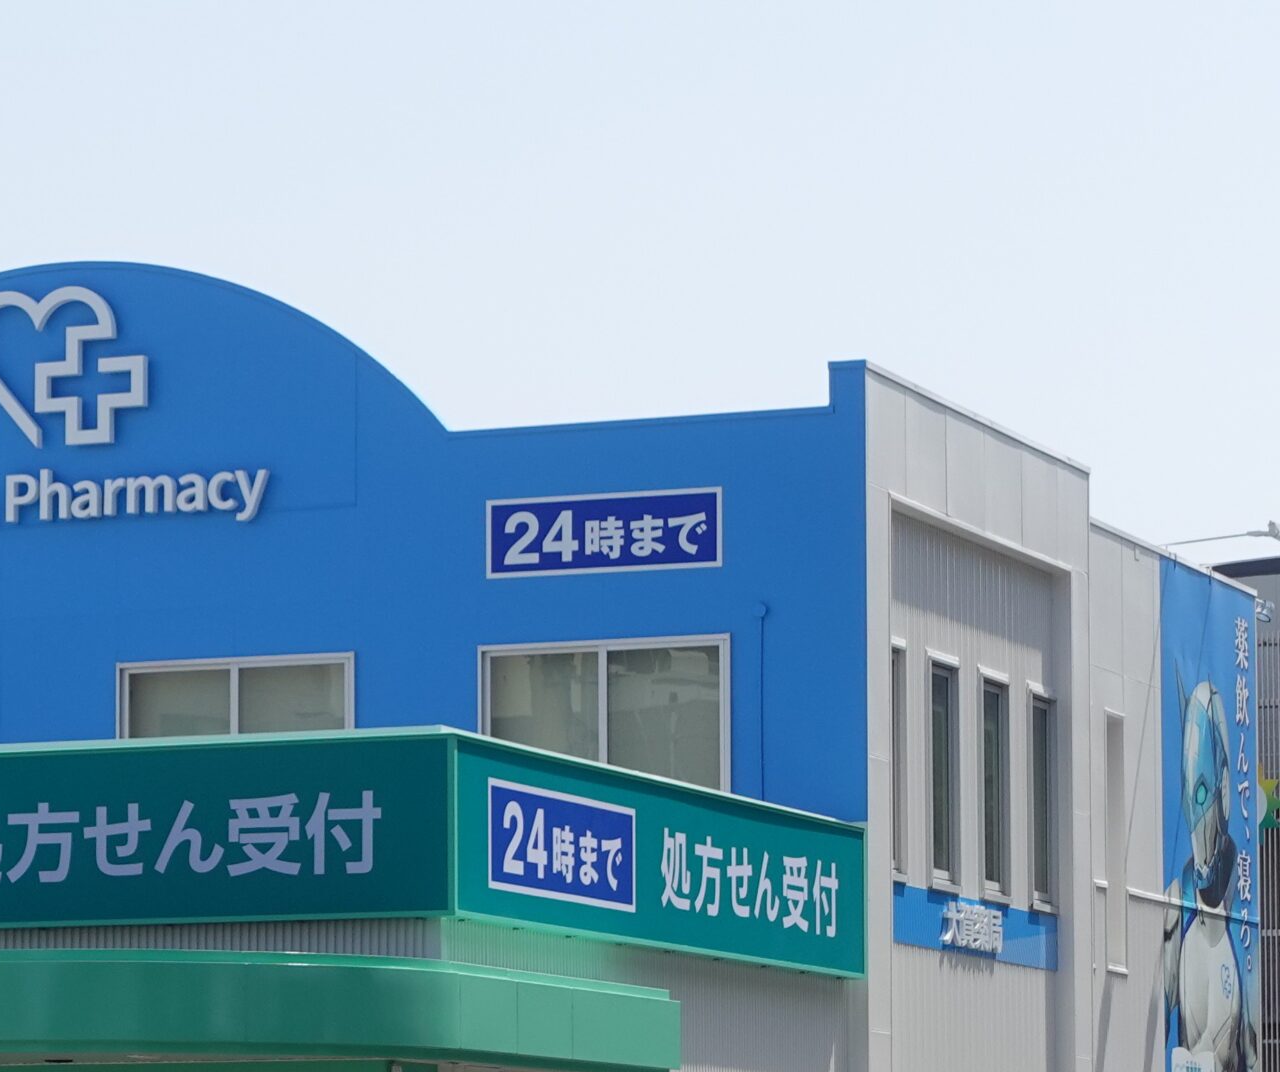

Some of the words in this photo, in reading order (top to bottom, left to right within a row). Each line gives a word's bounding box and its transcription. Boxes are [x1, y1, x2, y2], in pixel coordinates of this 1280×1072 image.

[5, 468, 270, 522] Pharmacy
[503, 509, 708, 566] 24時まで
[502, 799, 624, 892] 24時まで
[660, 826, 840, 938] 処方せん受付
[939, 900, 1003, 953] 大賀薬局
